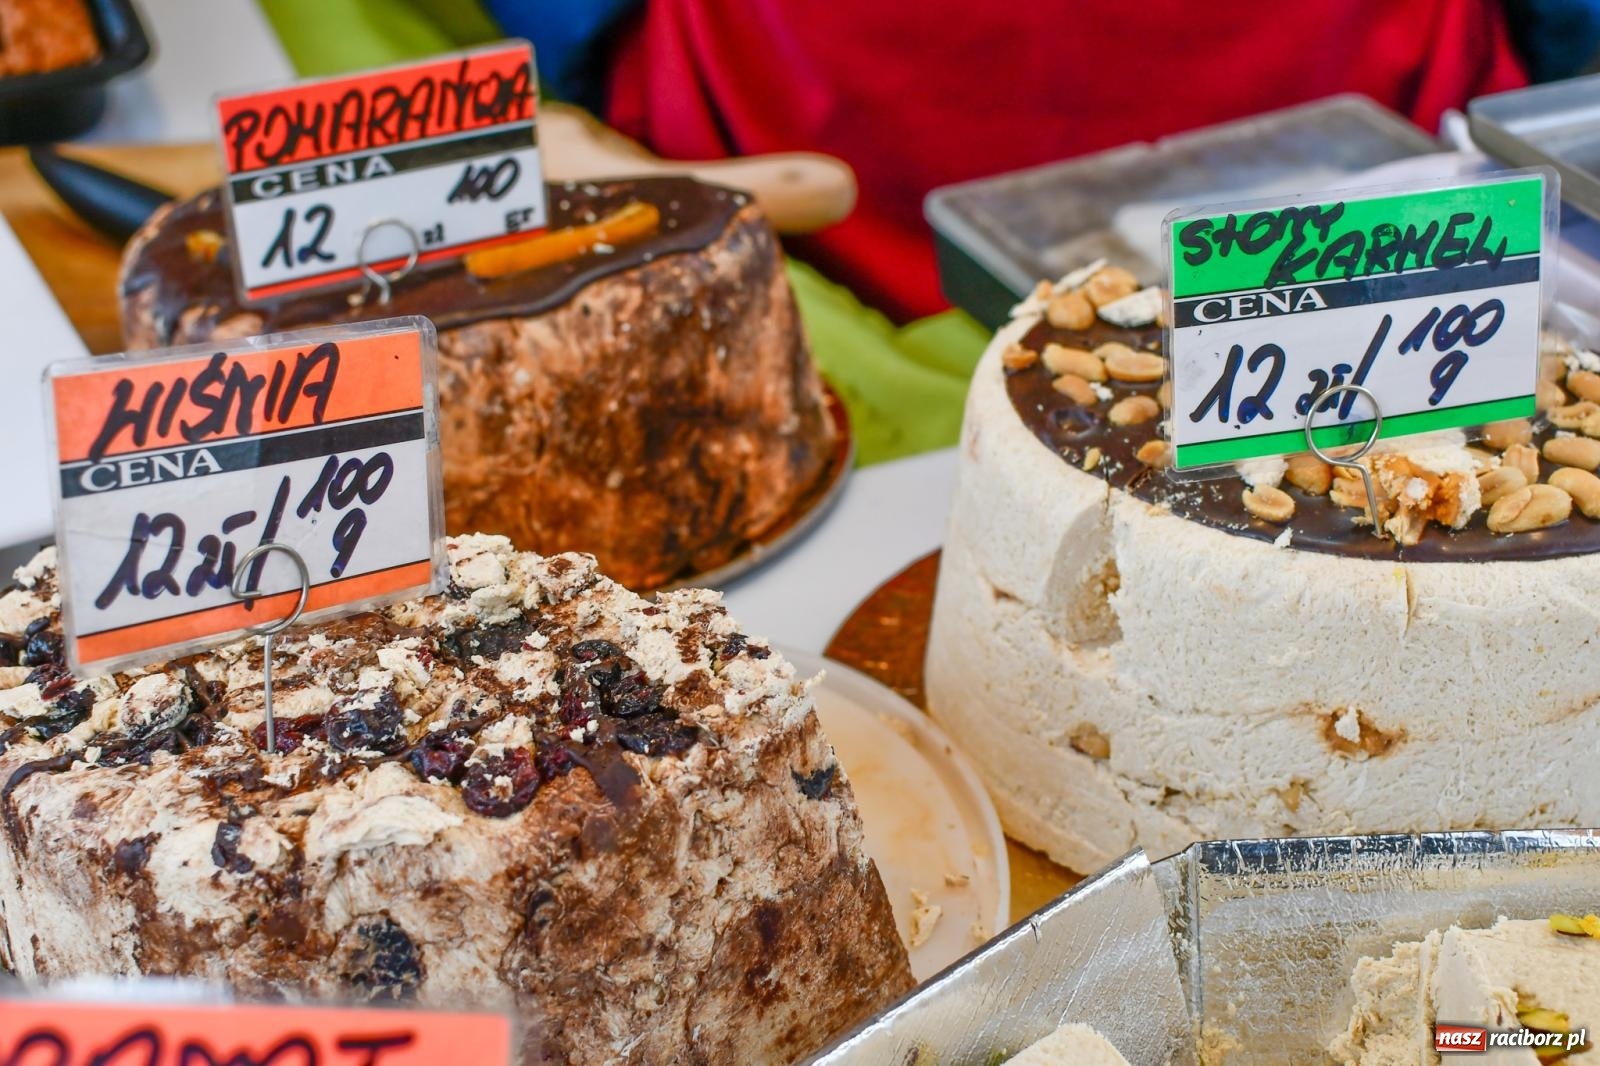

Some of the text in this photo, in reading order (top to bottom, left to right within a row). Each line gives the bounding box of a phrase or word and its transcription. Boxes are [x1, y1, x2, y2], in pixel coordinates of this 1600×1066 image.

[252, 155, 395, 199] CENA
[447, 157, 520, 203] 100
[262, 204, 336, 268] 12
[1193, 287, 1328, 323] CENA
[1189, 343, 1286, 424] 12
[1398, 299, 1505, 354] 100
[89, 342, 340, 463] WIŚNIA
[80, 448, 223, 493] CENA
[296, 452, 394, 519] 100
